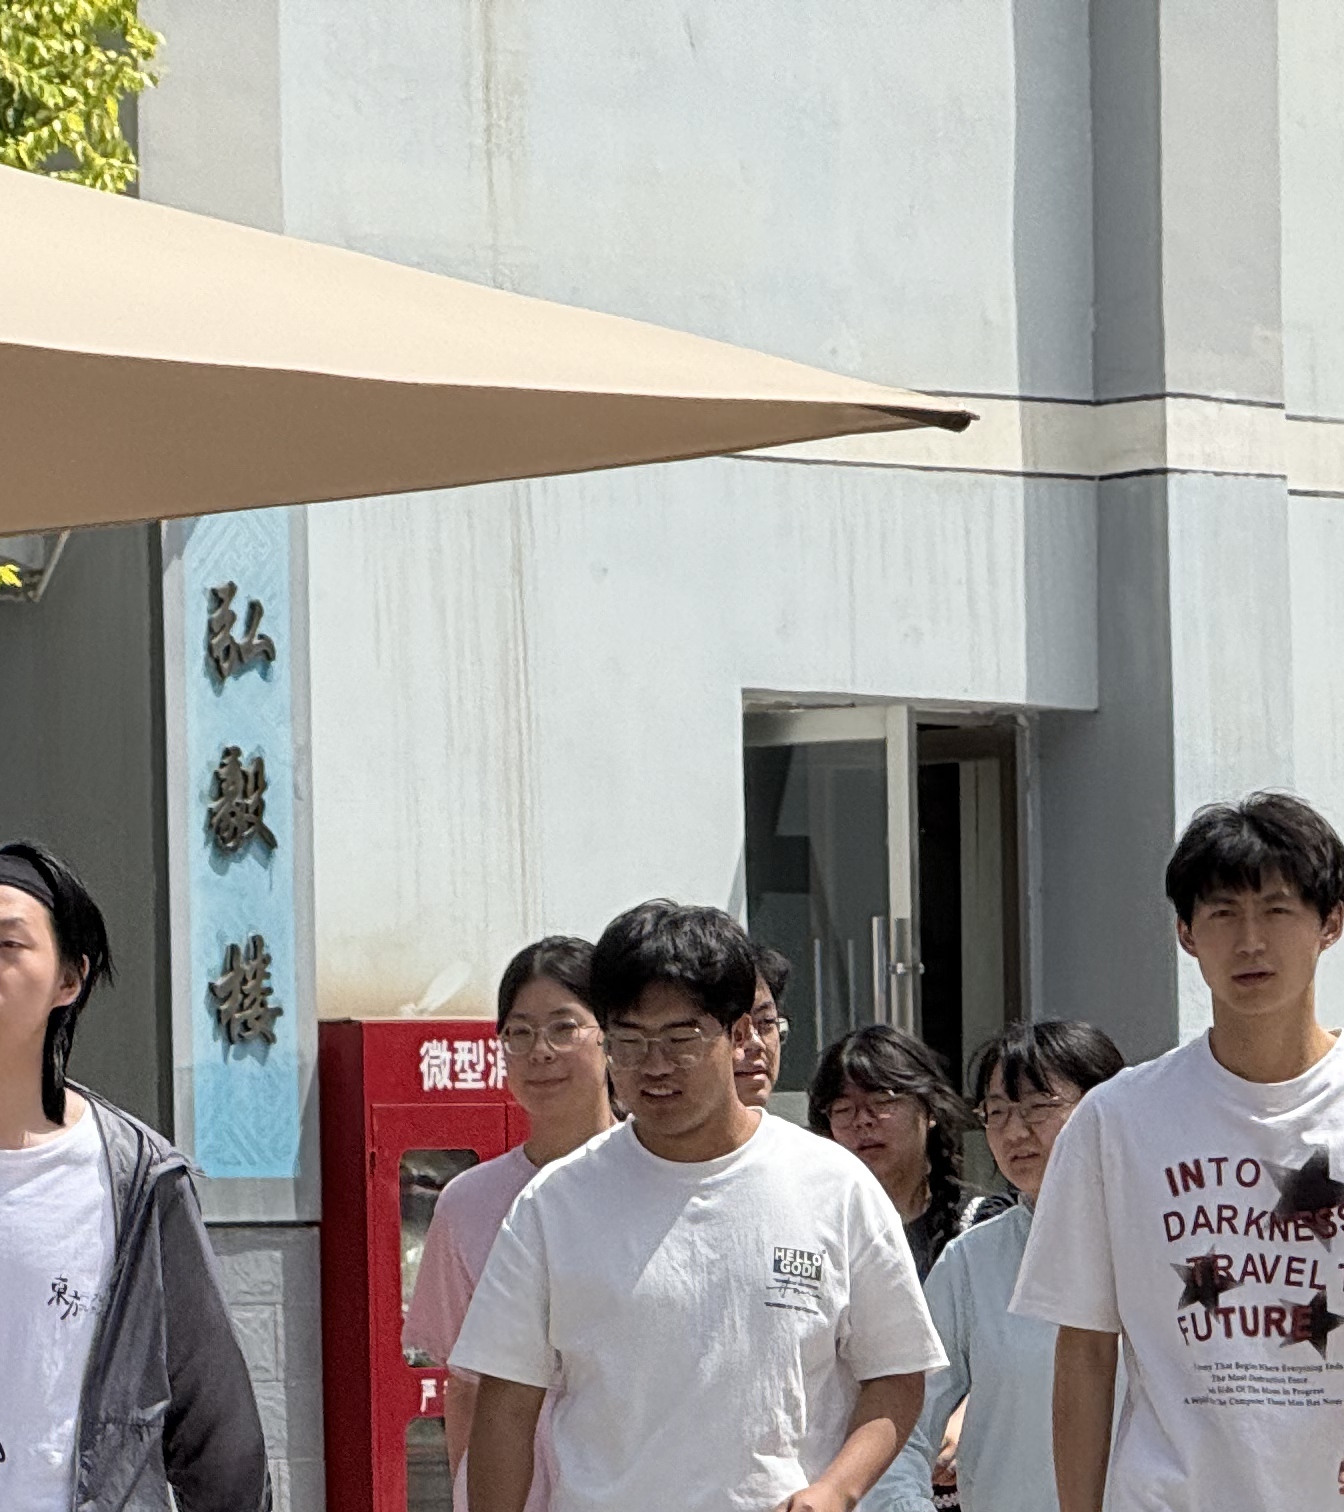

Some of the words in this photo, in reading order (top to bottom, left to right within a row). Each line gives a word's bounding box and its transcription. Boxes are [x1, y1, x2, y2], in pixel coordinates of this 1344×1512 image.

[1164, 1157, 1261, 1198] INTO
[775, 1248, 822, 1266] HELLO
[1186, 1253, 1326, 1290] TRAVEL
[1177, 1304, 1313, 1346] FUTURE
